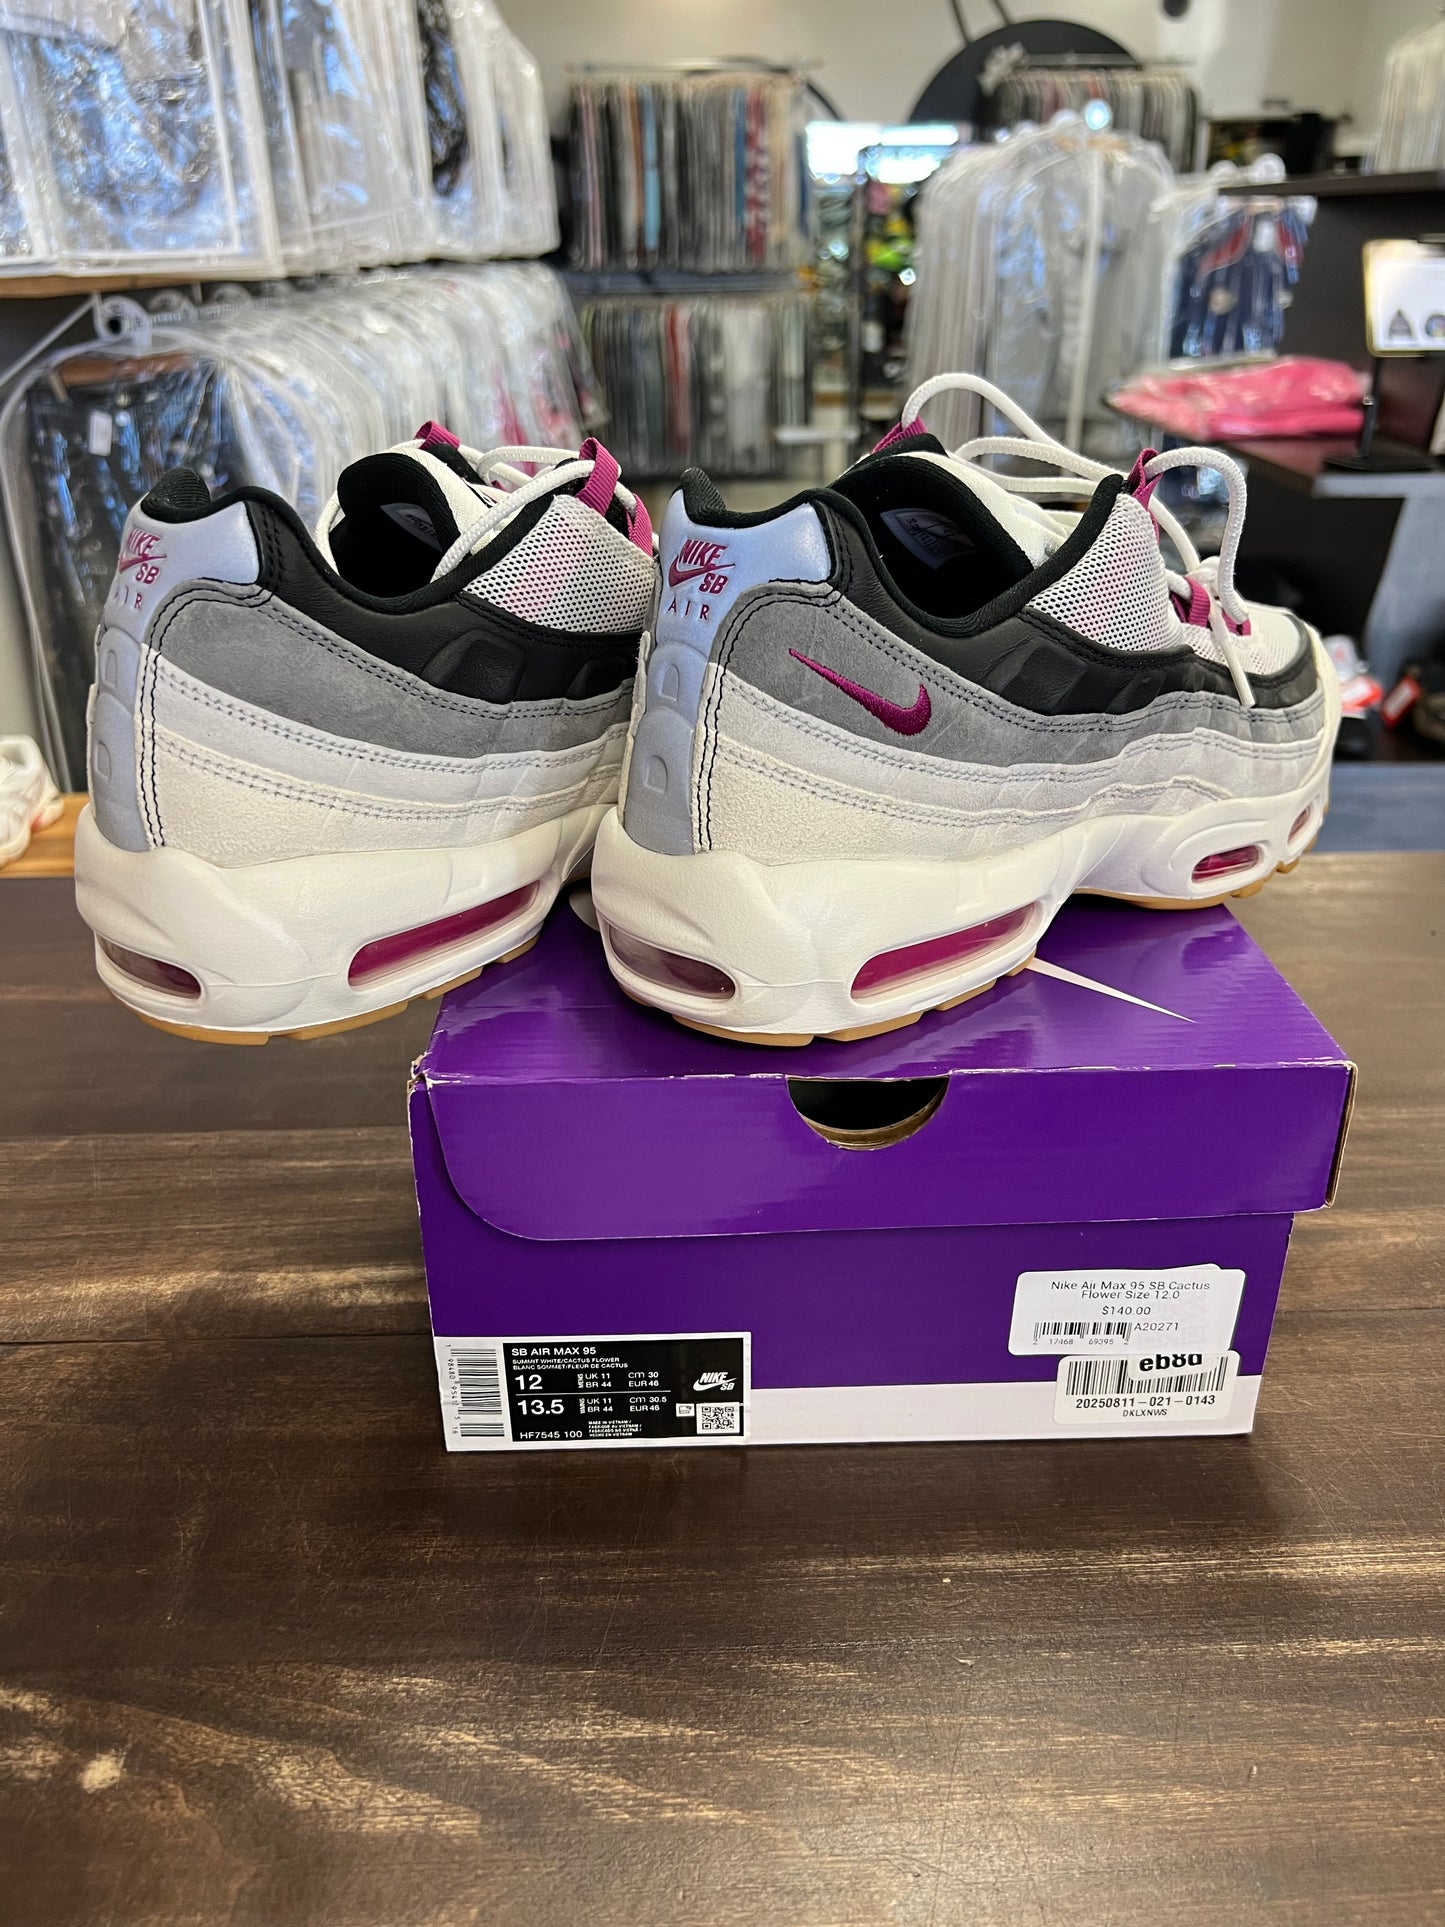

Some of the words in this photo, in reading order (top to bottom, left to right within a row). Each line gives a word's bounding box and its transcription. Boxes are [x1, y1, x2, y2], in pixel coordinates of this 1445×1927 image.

[678, 539, 728, 567] NIKE
[135, 562, 159, 584] SB
[699, 572, 729, 594] SB
[667, 595, 710, 620] AIR
[1051, 1281, 1078, 1290] Nike
[1081, 1281, 1097, 1290] Air
[1101, 1281, 1126, 1290] Max
[1130, 1281, 1145, 1290] 95
[1149, 1281, 1165, 1290] SB
[1169, 1281, 1210, 1290] Cactus
[1082, 1290, 1121, 1299] Flower
[1125, 1290, 1150, 1299] Size
[1155, 1290, 1180, 1299] 12.0
[1102, 1305, 1151, 1316] $140.00
[1134, 1322, 1179, 1331] A20271
[511, 1348, 528, 1356] SB
[530, 1347, 551, 1356] AIR
[553, 1347, 580, 1355] MAX
[582, 1346, 597, 1355] 95
[699, 1371, 729, 1383] NIKE
[515, 1374, 543, 1390] 12
[648, 1379, 659, 1387] 46
[720, 1382, 735, 1391] SB
[648, 1395, 667, 1403] 30.5
[517, 1399, 565, 1415] 13.5
[602, 1405, 614, 1413] 44
[1122, 1409, 1168, 1417] DKLXNWS
[520, 1431, 560, 1439] HF7545
[564, 1430, 583, 1438] 100
